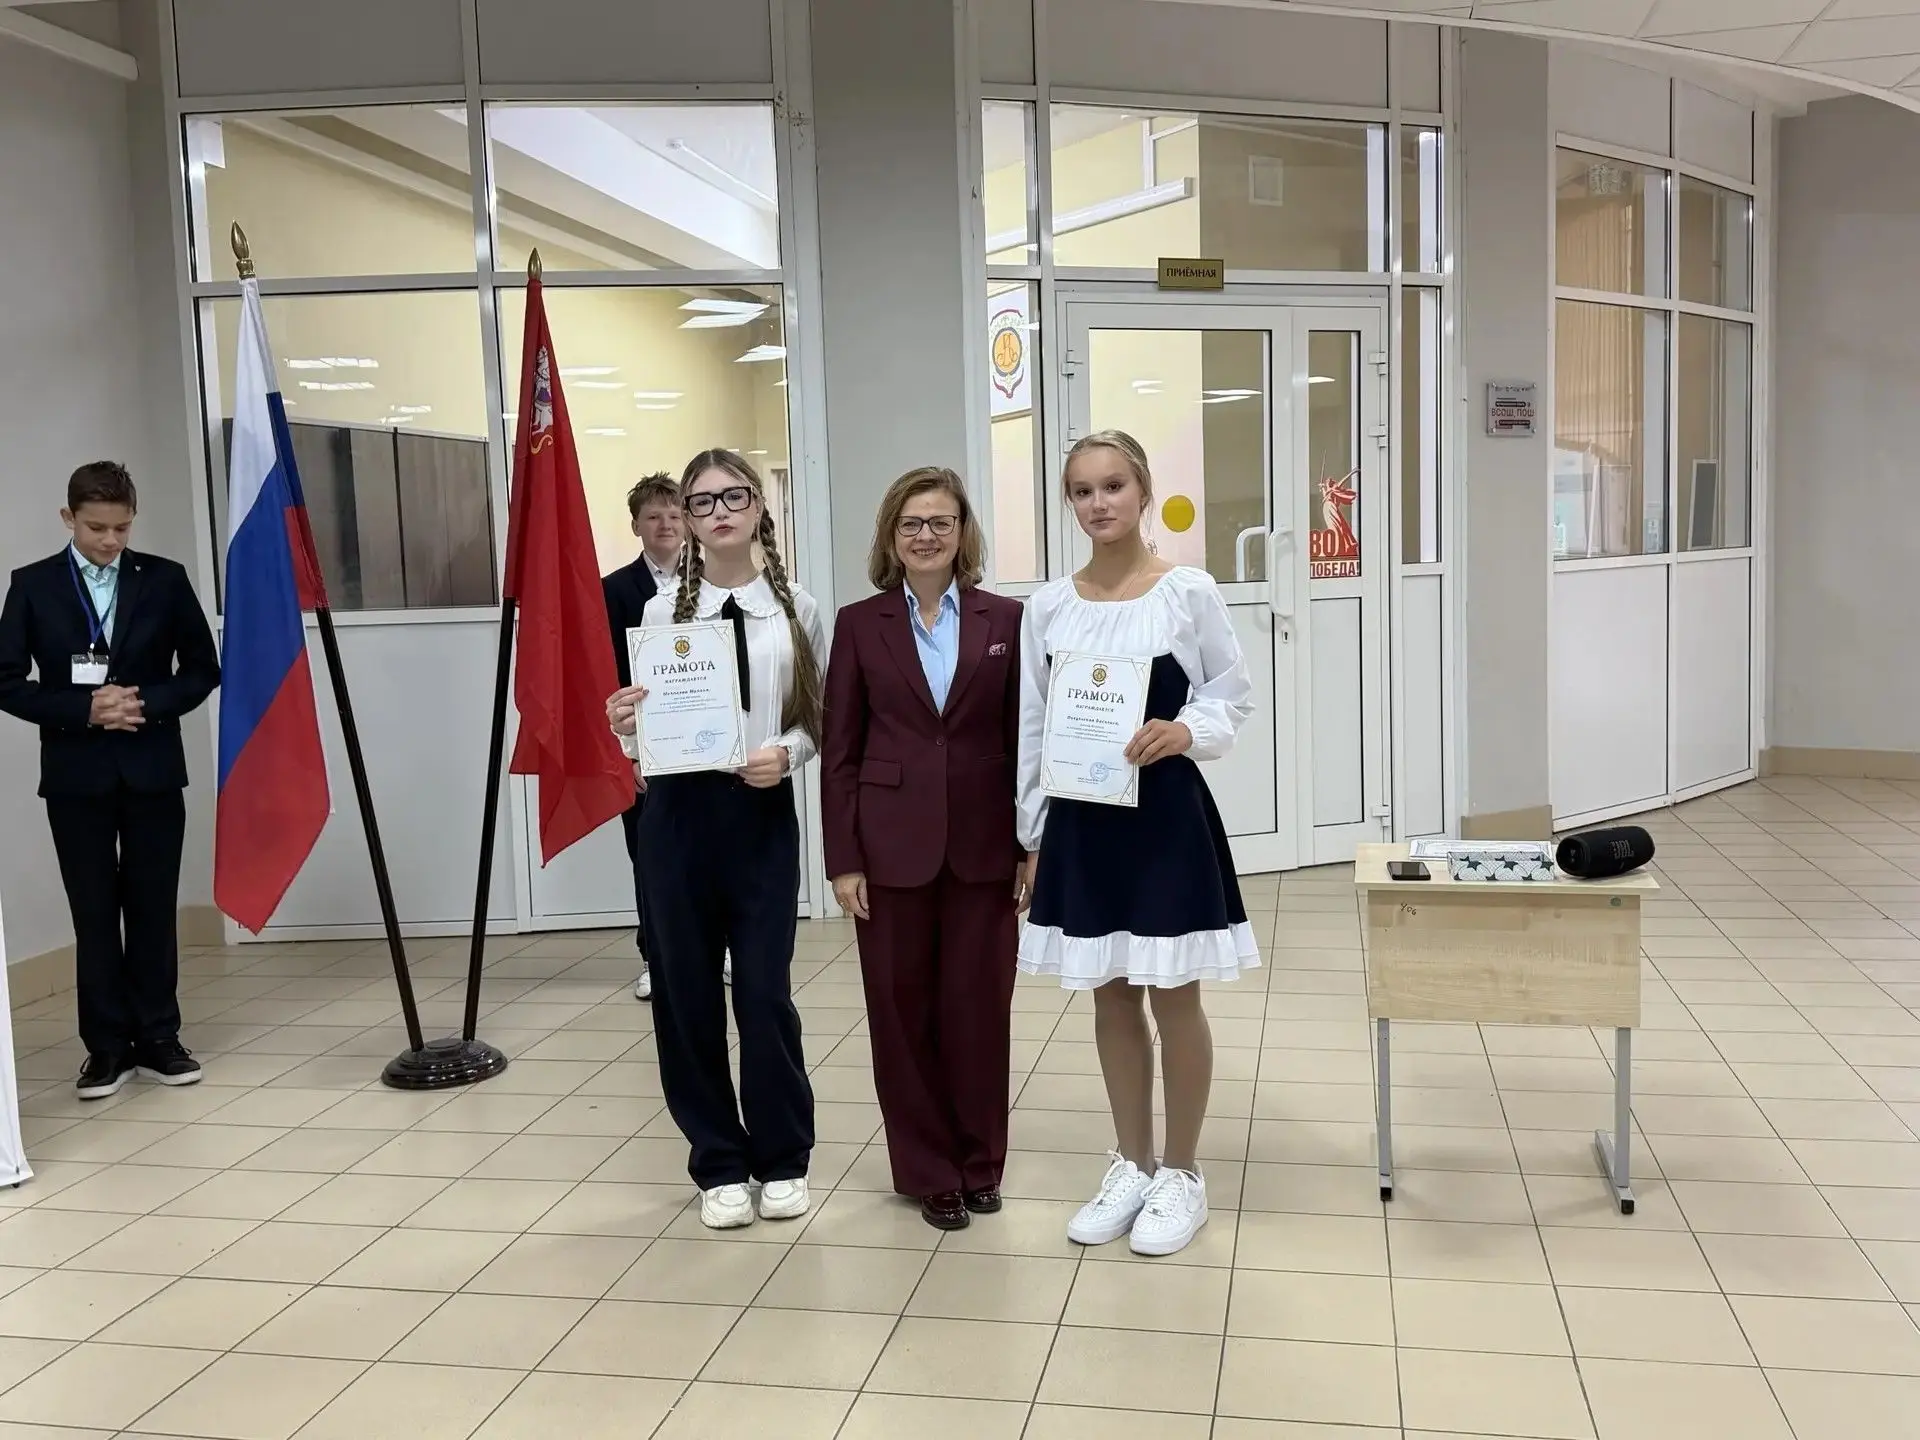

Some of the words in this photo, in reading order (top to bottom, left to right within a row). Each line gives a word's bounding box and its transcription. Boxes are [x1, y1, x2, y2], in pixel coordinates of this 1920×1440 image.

[1166, 266, 1216, 277] ПРИЁМНАЯ
[653, 660, 715, 675] ГРАМОТА
[1067, 688, 1124, 704] ГРАМОТА
[1610, 840, 1634, 859] JBL
